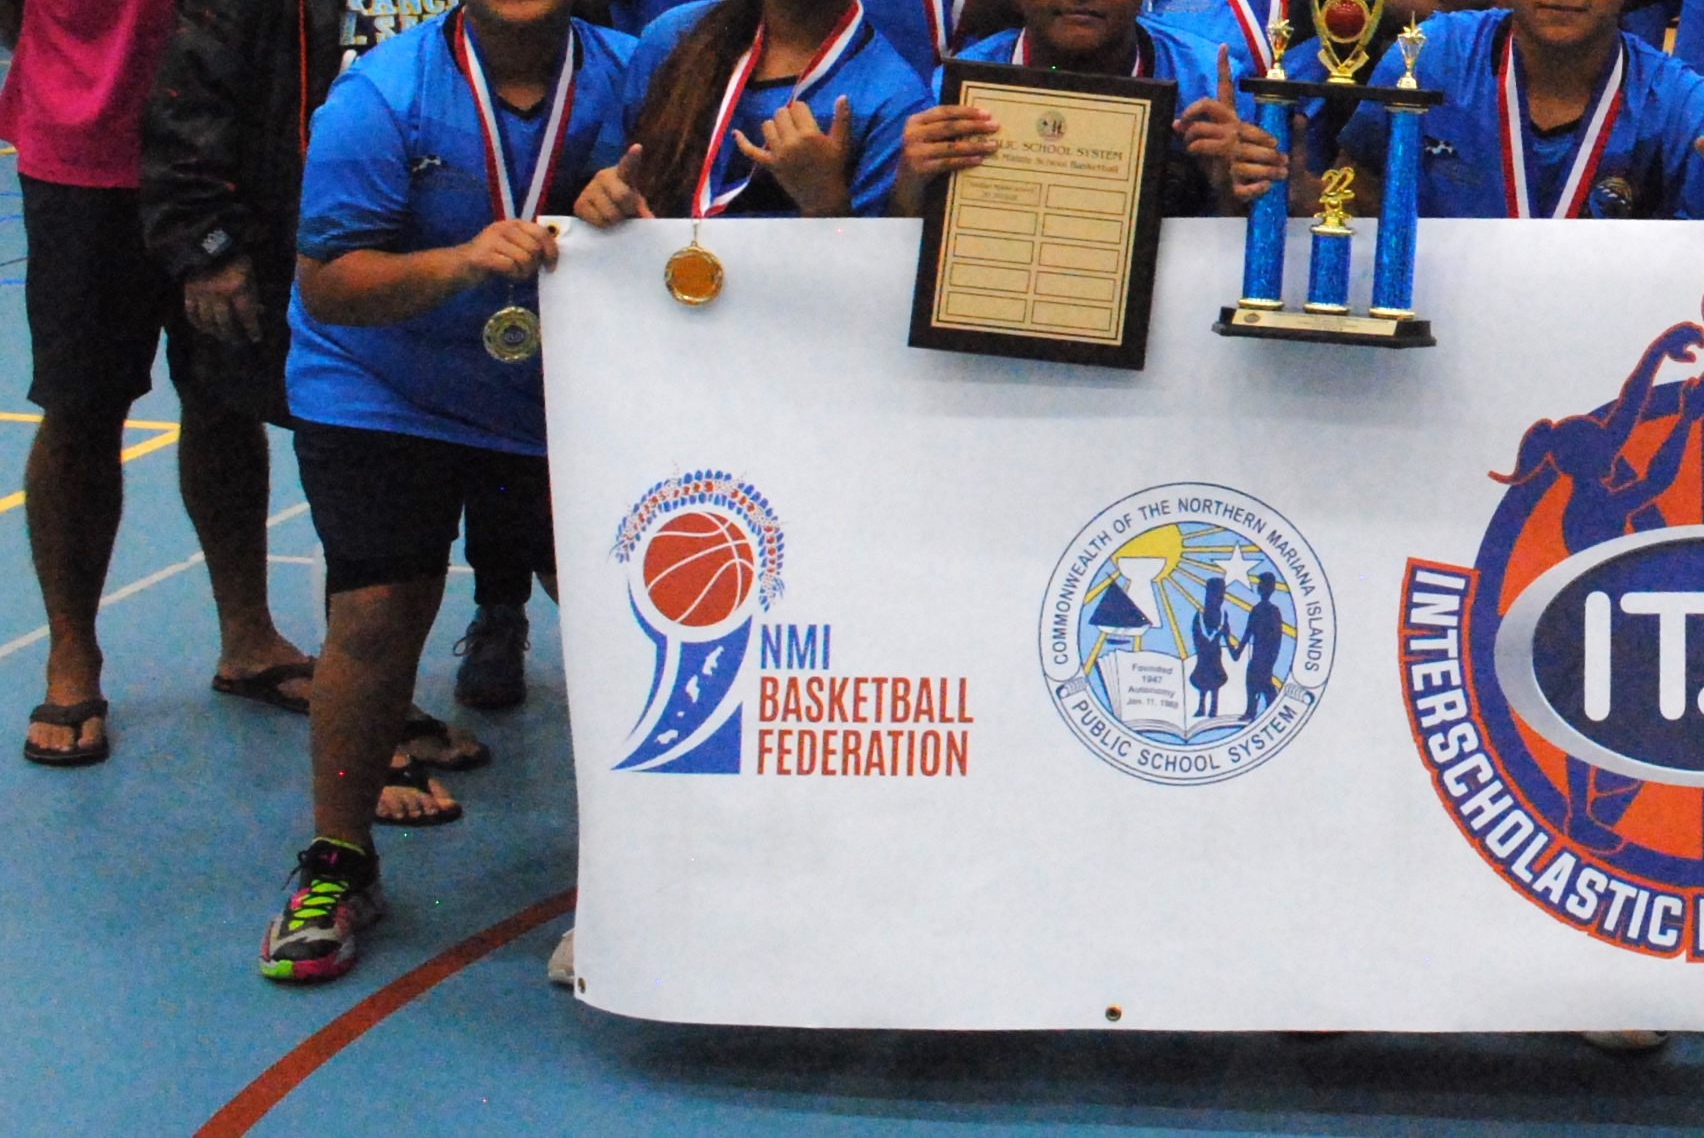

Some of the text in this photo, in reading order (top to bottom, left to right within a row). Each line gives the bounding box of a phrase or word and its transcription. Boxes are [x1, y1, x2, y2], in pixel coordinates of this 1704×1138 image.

[1022, 142, 1074, 155] SCHOOL
[1076, 148, 1124, 161] SYSTEM
[1053, 497, 1324, 672] COMMONWEALTH OF THE NORTHERN MARIANA ISLANDS
[758, 623, 831, 671] NMI
[1131, 663, 1174, 675] Founded
[759, 675, 975, 724] BASKETBALL
[757, 727, 970, 777] FEDERATION
[1072, 699, 1298, 773] PUBLIC SCHOOL SYSTEM
[1409, 569, 1683, 947] INTERSCHOLASTIC
